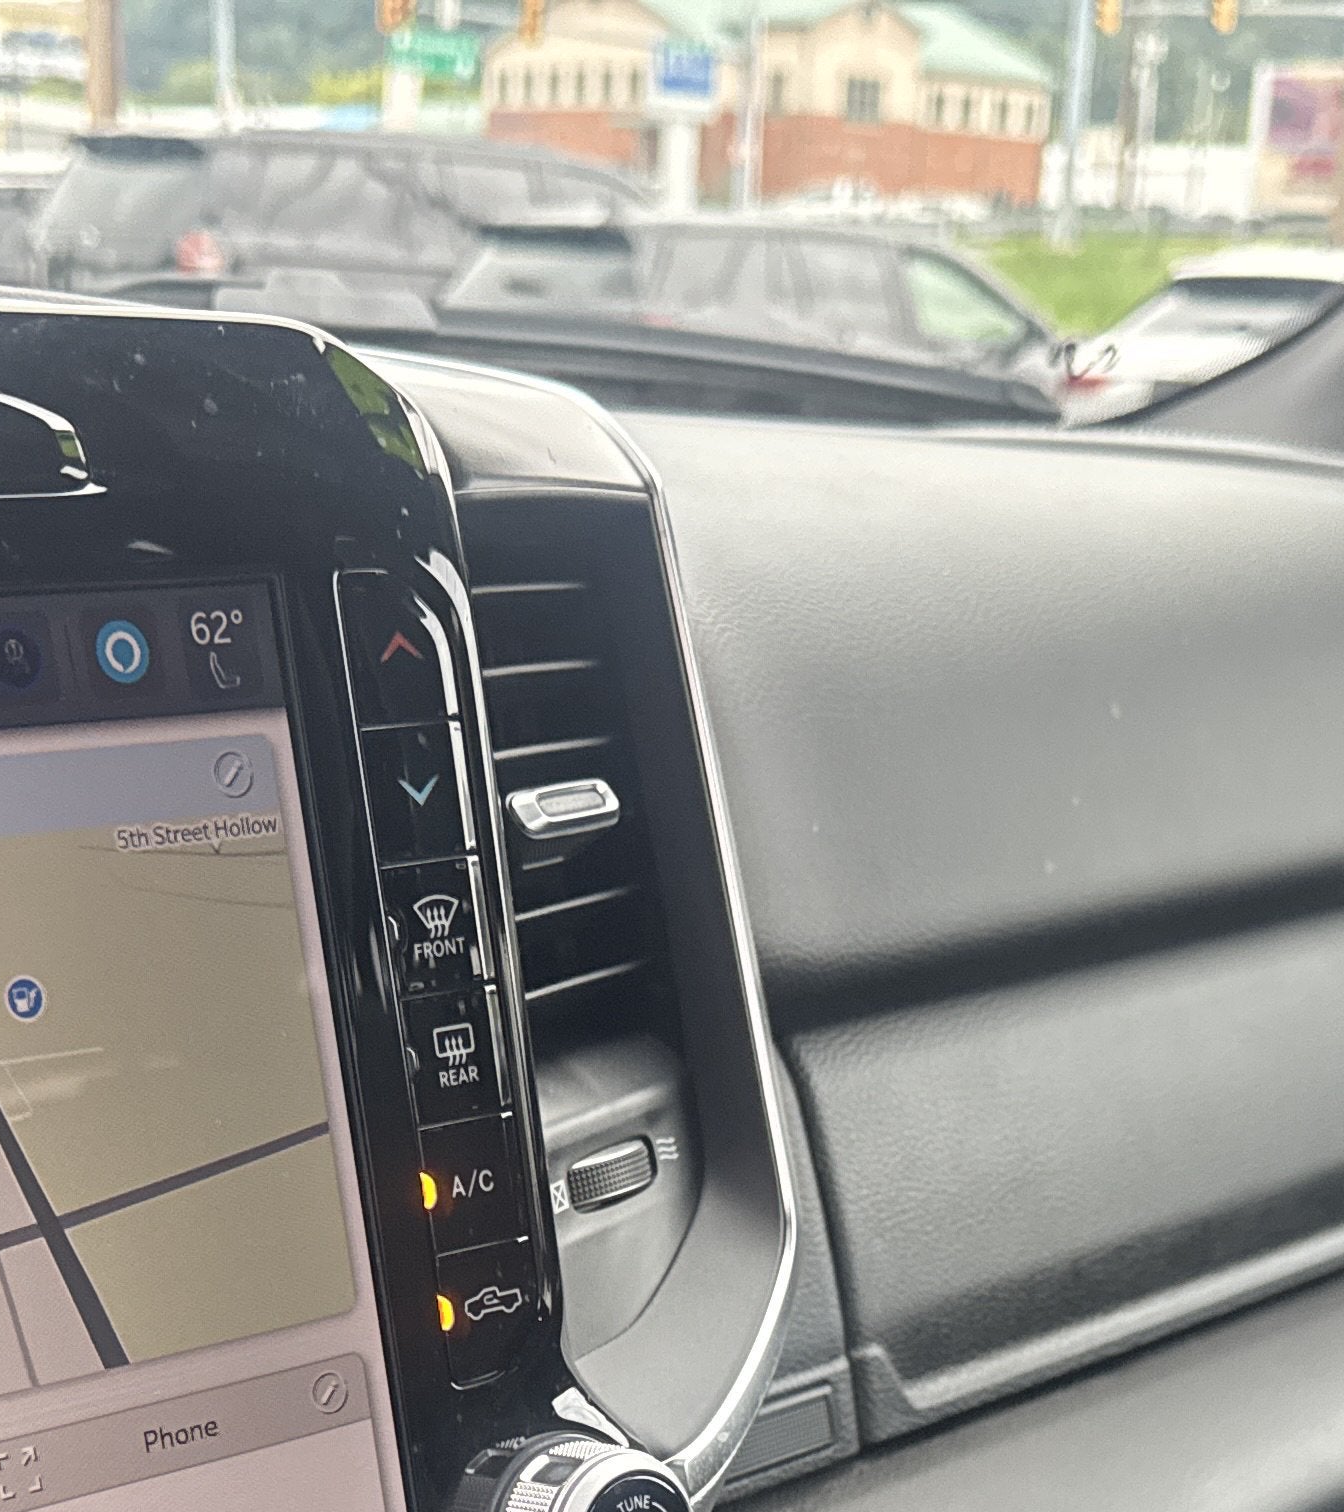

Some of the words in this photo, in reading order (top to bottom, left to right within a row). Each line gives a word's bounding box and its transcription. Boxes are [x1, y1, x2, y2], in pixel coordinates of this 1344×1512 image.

[190, 610, 244, 646] 62°
[117, 827, 149, 851] 5th
[153, 822, 210, 847] Street
[214, 815, 278, 841] Hollow
[414, 937, 466, 960] FRONT
[439, 1065, 480, 1088] REAR
[452, 1169, 495, 1199] A/C
[143, 1418, 219, 1453] Phone
